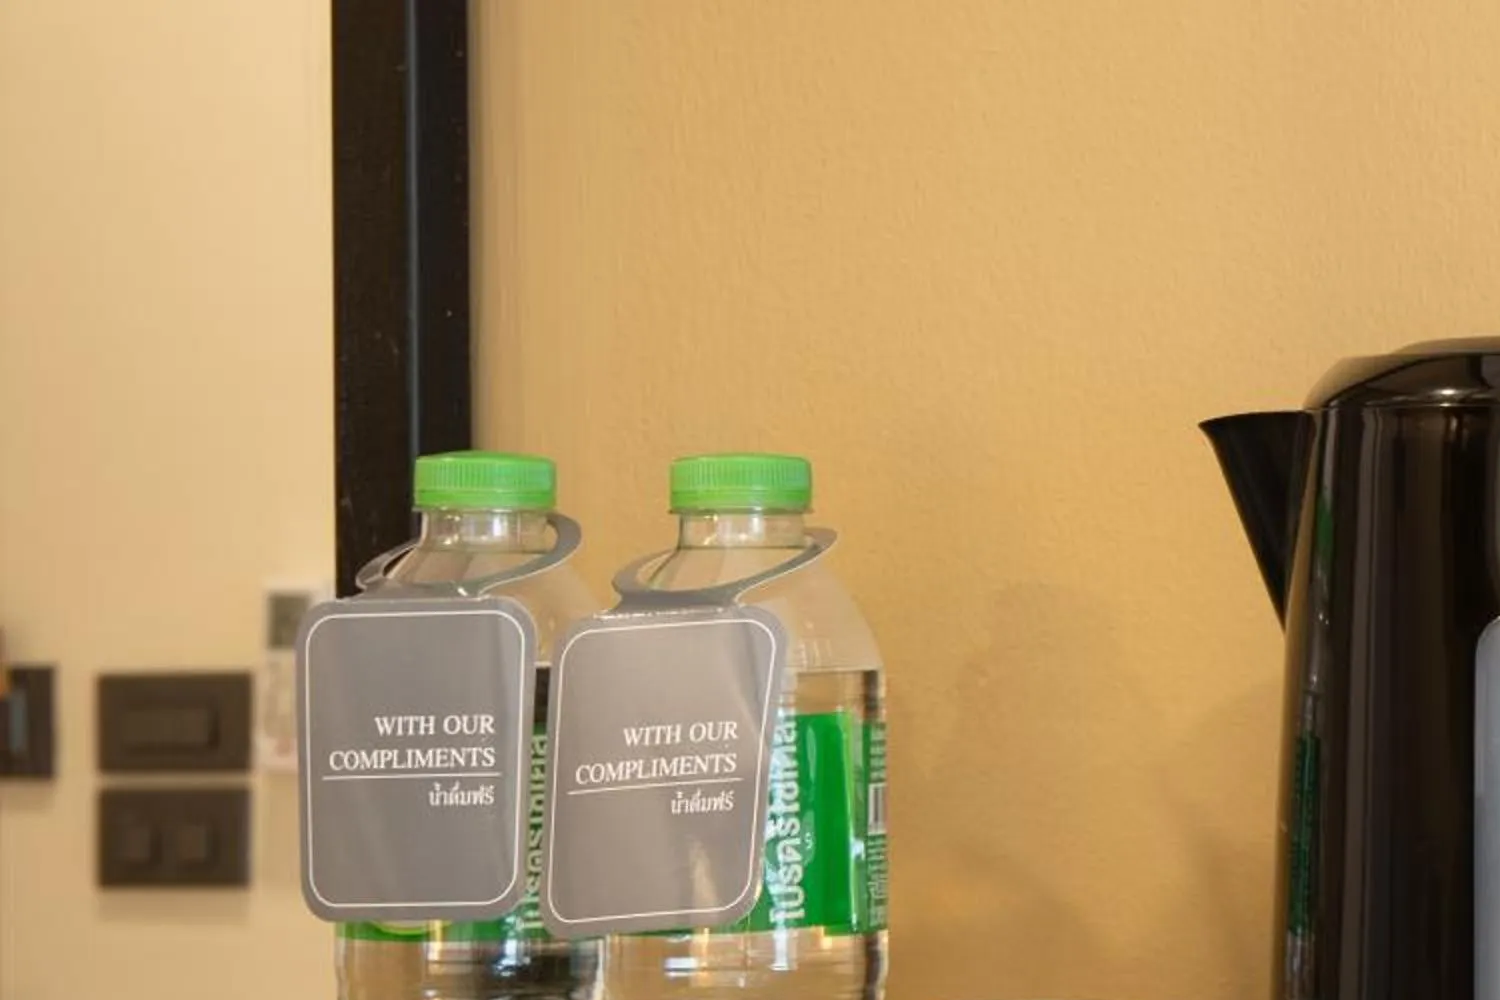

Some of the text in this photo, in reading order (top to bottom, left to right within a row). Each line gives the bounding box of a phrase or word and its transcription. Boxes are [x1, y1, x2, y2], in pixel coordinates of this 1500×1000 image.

[374, 714, 496, 736] WITH OUR
[623, 720, 739, 747] WITH OUR
[329, 746, 496, 771] COMPLIMENTS
[575, 752, 738, 785] COMPLIMENTS
